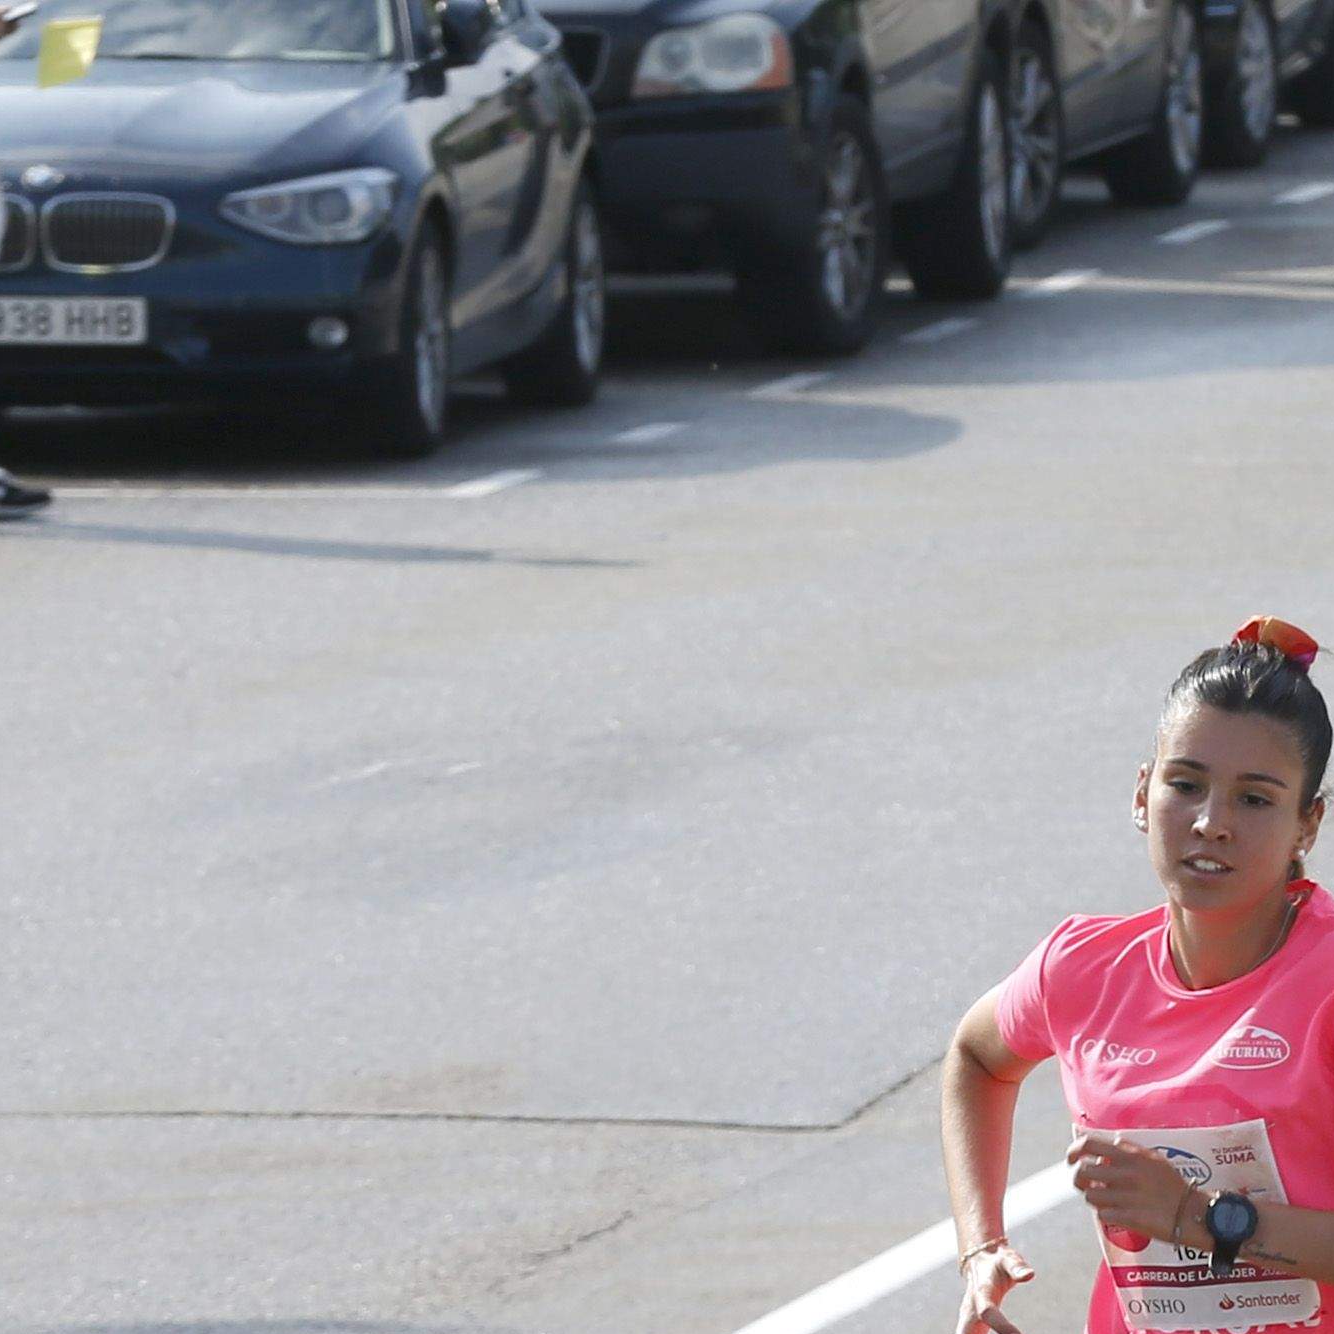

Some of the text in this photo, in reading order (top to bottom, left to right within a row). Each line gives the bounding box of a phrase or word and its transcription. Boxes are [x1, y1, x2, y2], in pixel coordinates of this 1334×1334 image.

[1215, 1151, 1256, 1166] SUMA
[1127, 1271, 1177, 1283] CARRERA
[1178, 1271, 1196, 1283] DE
[1198, 1269, 1214, 1281] LA
[1128, 1299, 1186, 1315] OYSHO
[1237, 1292, 1301, 1309] Santander
